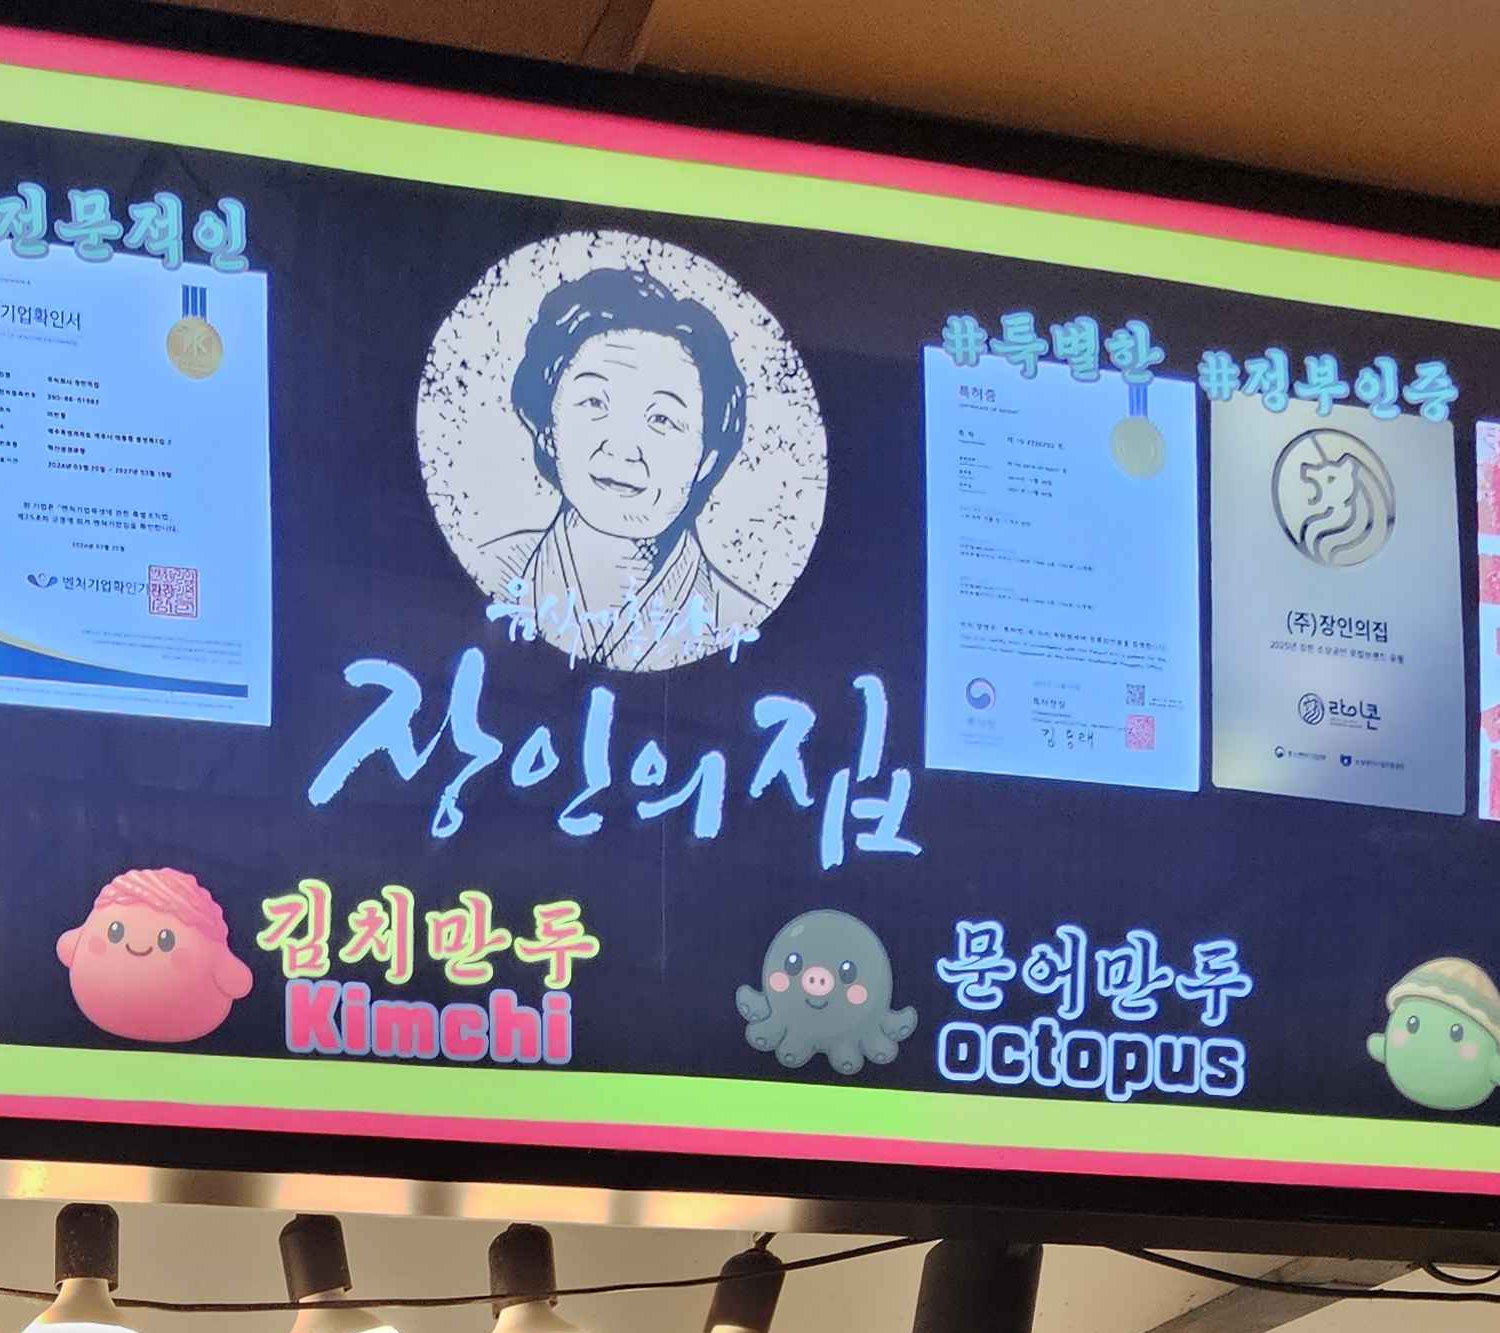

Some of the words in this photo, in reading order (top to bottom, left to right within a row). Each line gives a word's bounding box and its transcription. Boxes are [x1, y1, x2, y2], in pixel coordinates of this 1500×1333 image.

[942, 311, 1163, 384] #특별한
[1198, 347, 1459, 421] #정부인증
[1287, 610, 1389, 643] (주)장인의집
[308, 648, 923, 870] 장인의집
[256, 879, 599, 990] 김치만두
[933, 918, 1253, 1035] 문어만두
[284, 980, 573, 1066] Kimchi
[936, 1018, 1246, 1102] octopus
